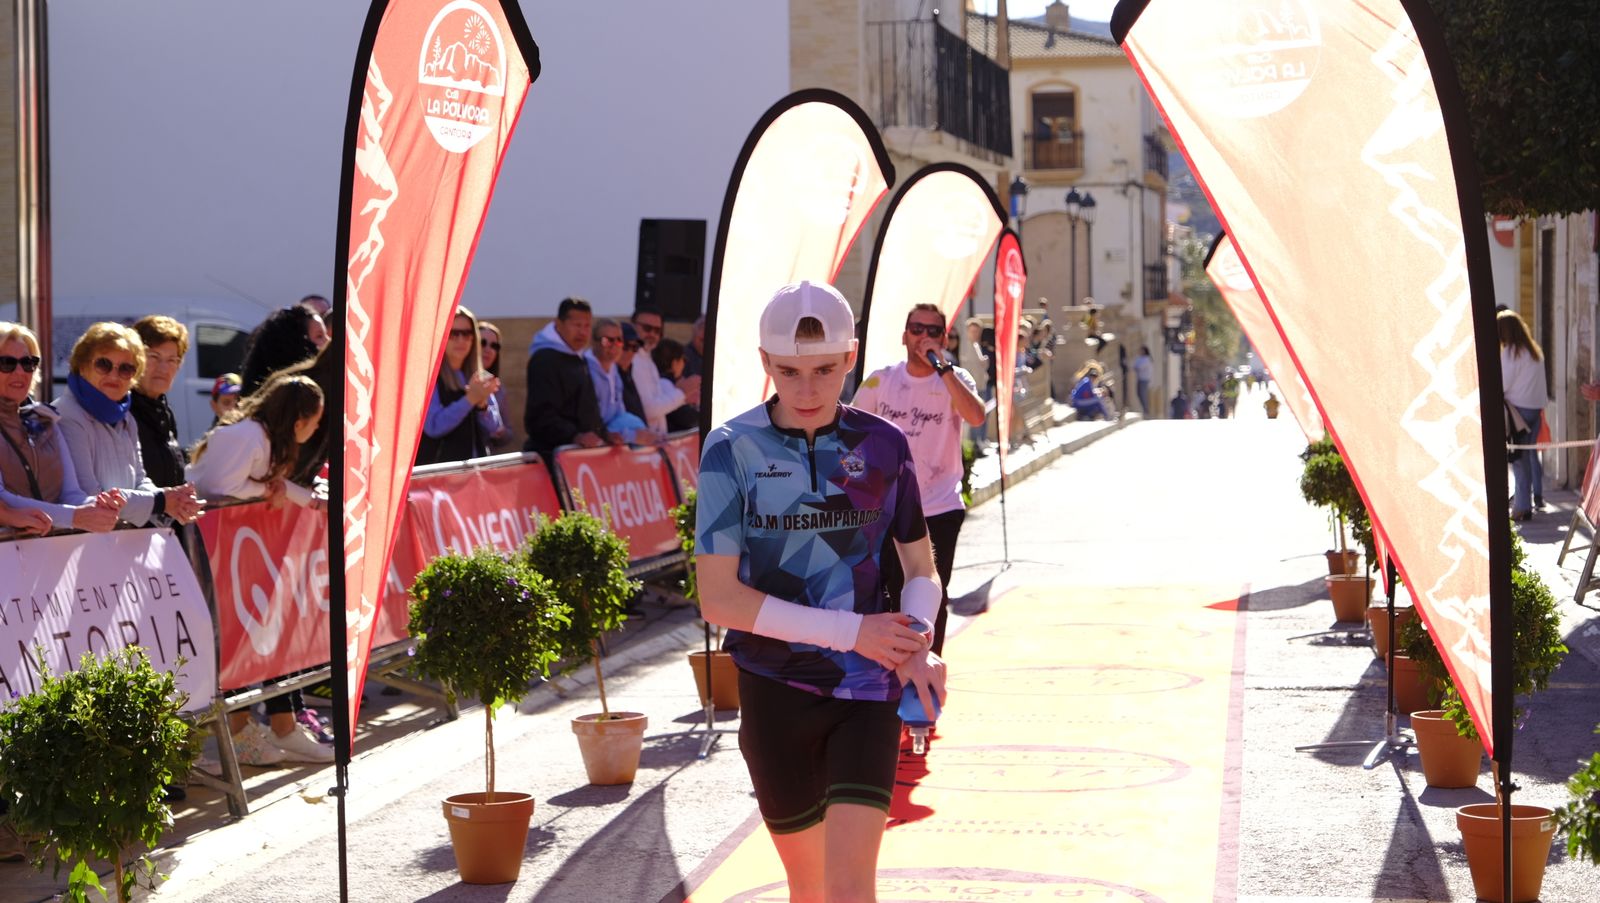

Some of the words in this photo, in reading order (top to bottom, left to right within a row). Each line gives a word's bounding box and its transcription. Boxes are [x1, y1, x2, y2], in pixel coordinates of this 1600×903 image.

[426, 97, 441, 115] LA
[879, 401, 908, 421] Pepe
[602, 479, 667, 530] VEOLIA
[782, 508, 882, 531] DESAMPARADO
[149, 573, 180, 600] DE
